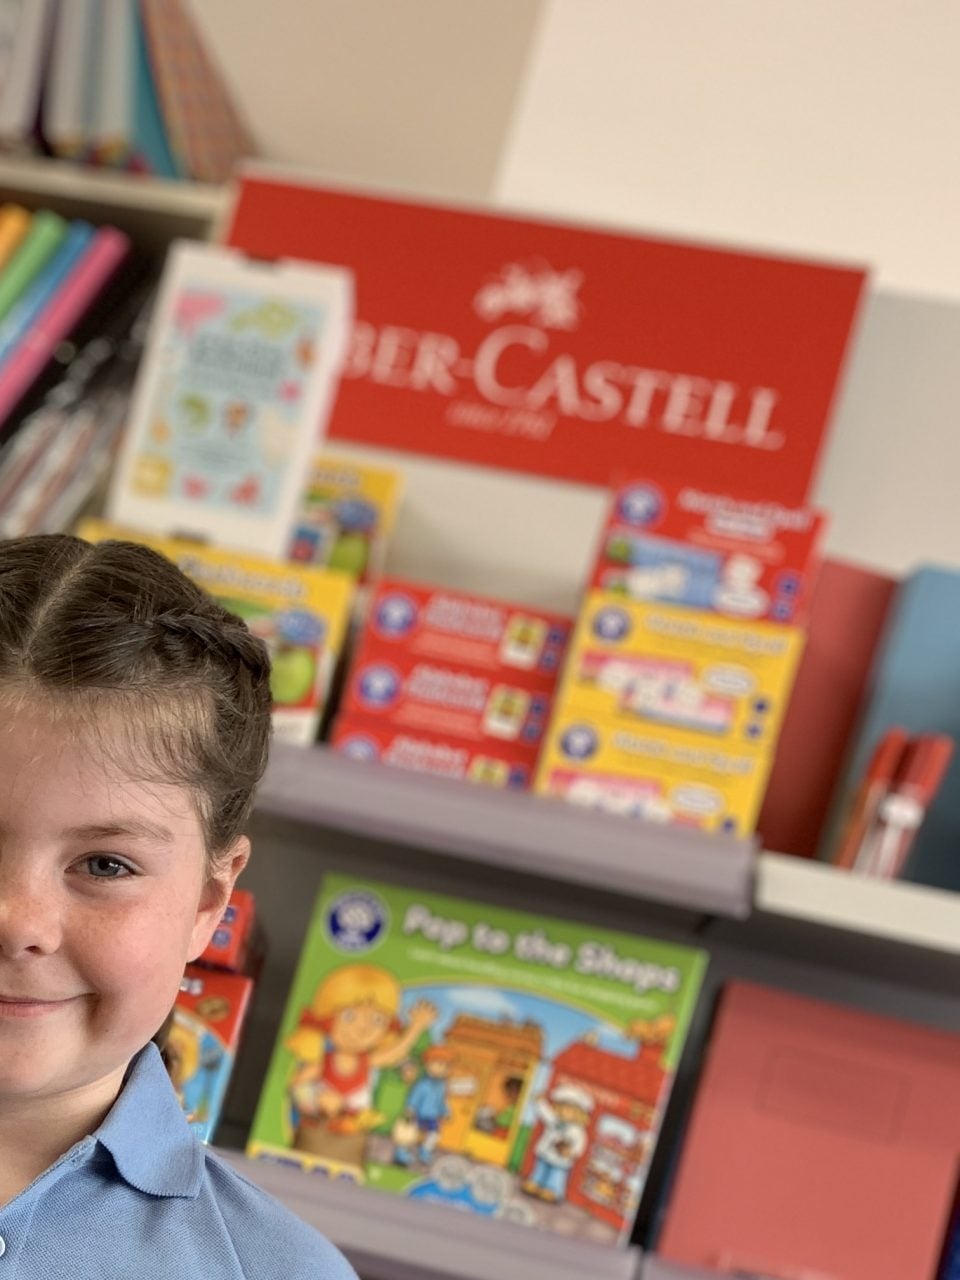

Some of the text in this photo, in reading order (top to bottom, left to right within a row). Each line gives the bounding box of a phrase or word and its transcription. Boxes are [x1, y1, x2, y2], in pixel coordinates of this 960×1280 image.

[340, 323, 783, 449] BER-CASTELL
[404, 904, 467, 949] Pop
[473, 922, 510, 953] to
[515, 931, 571, 967] the
[576, 942, 681, 992] Shops
